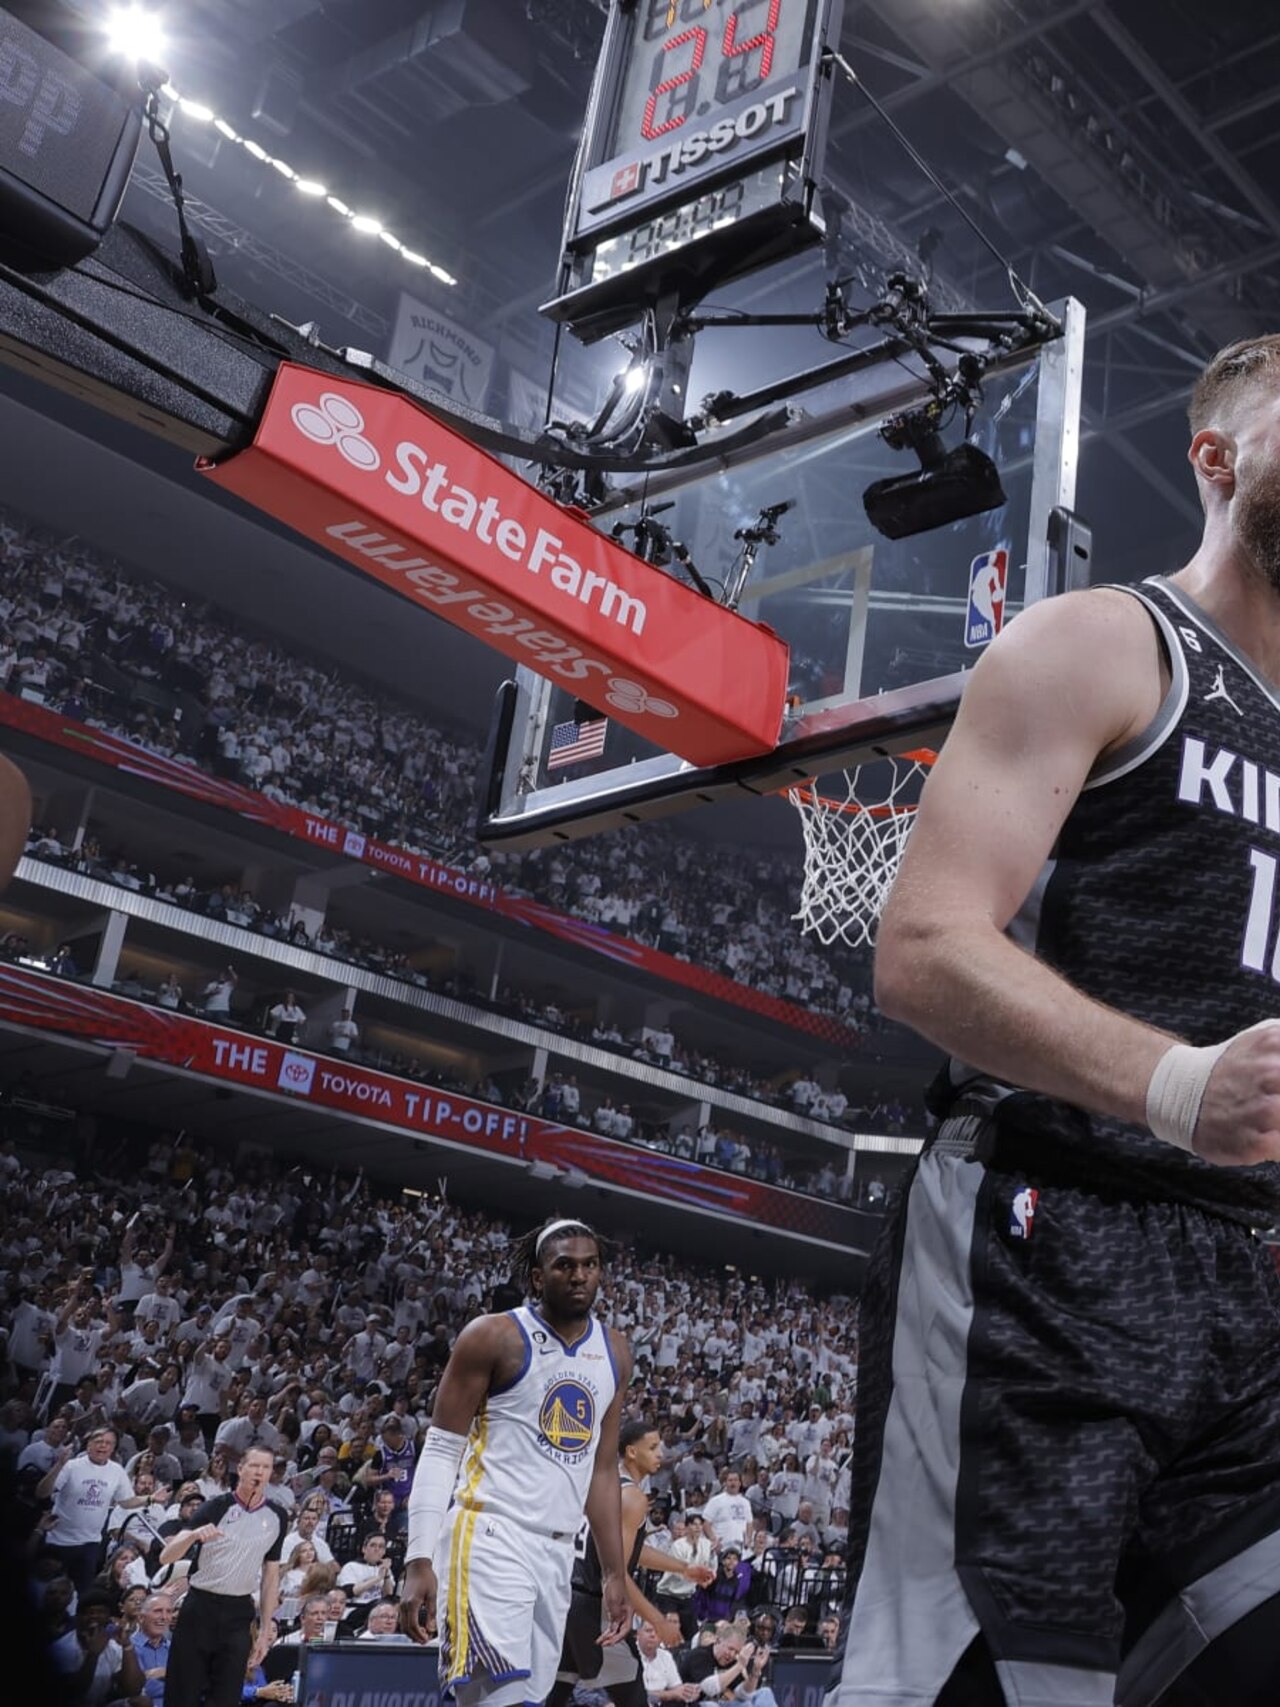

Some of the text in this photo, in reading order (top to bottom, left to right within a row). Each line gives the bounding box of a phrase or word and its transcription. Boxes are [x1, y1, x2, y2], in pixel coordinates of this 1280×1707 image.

[642, 86, 797, 184] TISSOT
[410, 313, 482, 367] RICHMOND
[970, 620, 988, 642] NBA
[304, 818, 496, 903] THE TOYOTA TIP-OFF!
[212, 1038, 528, 1144] THE TOYOTA TIP-OFF!
[576, 1399, 587, 1421] 5
